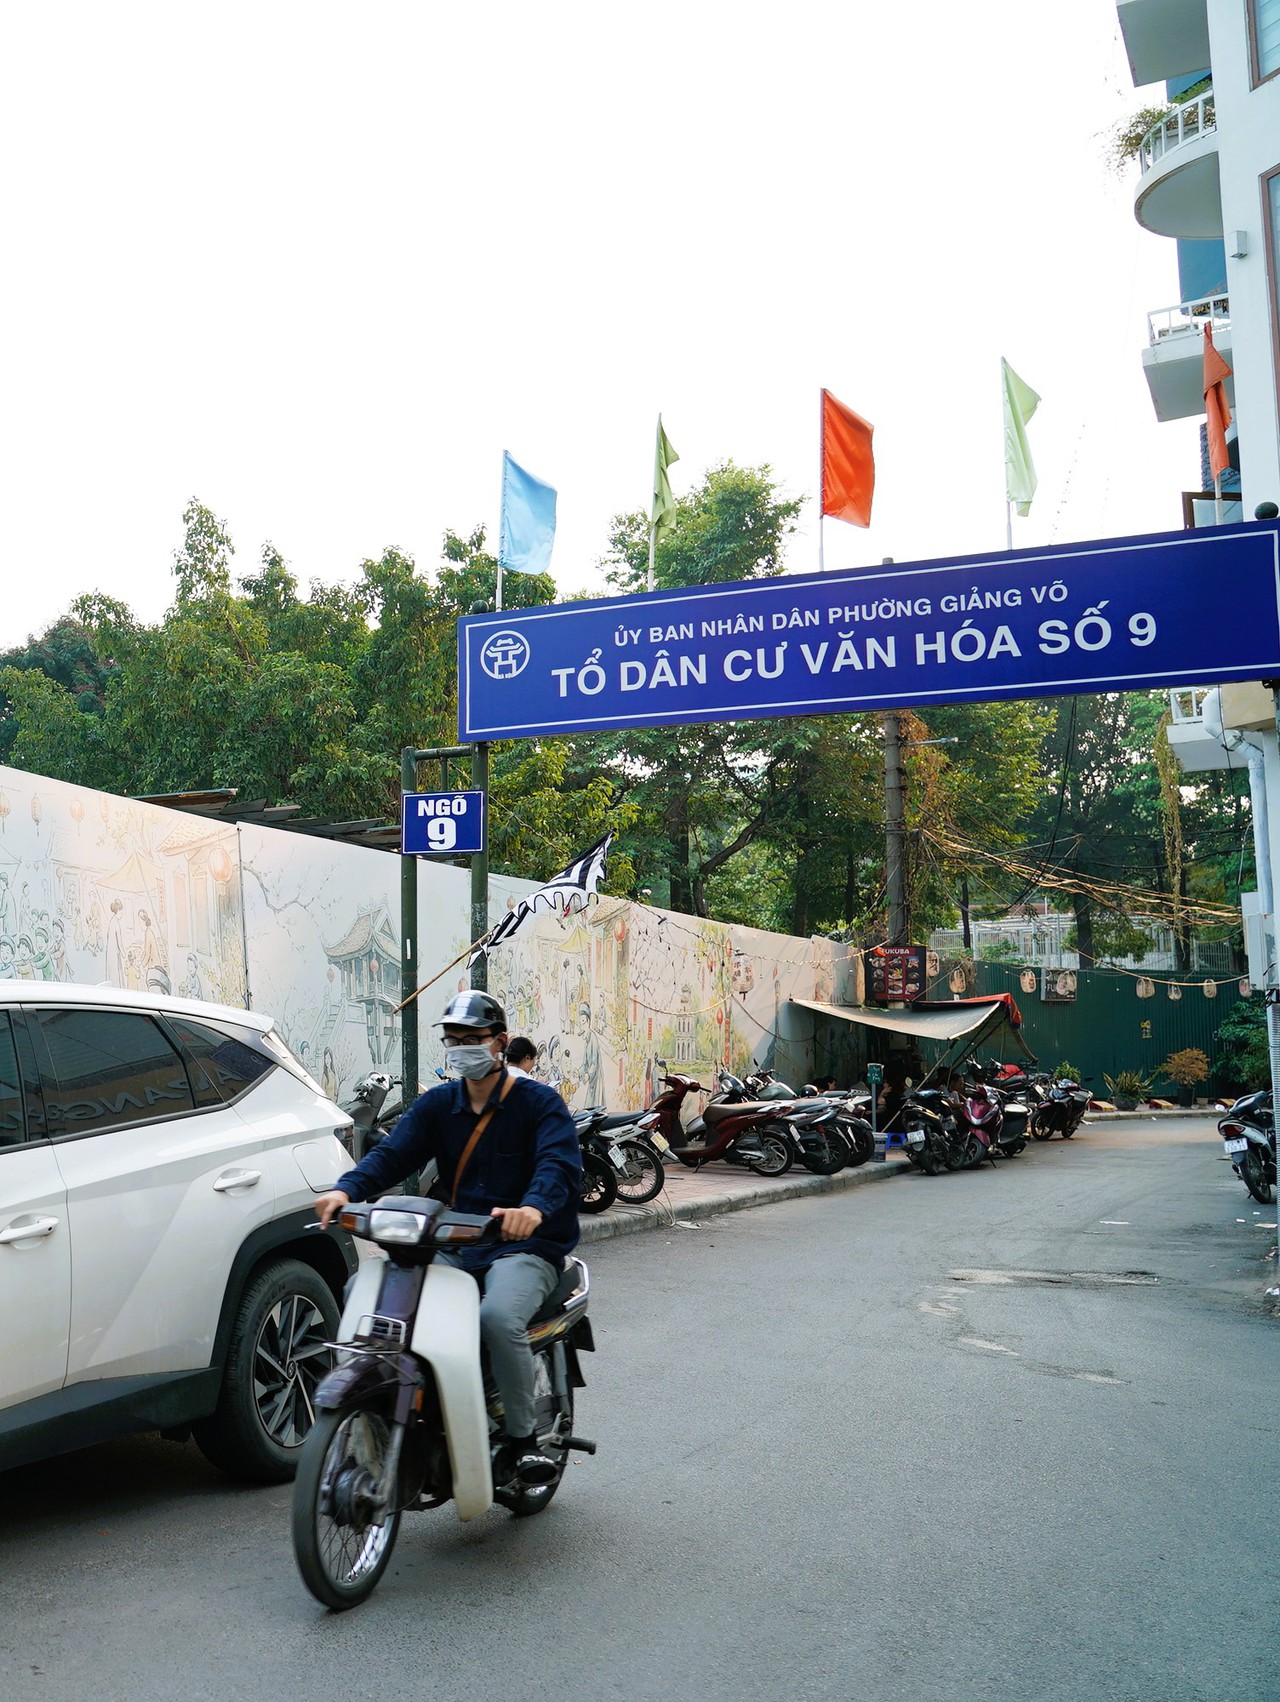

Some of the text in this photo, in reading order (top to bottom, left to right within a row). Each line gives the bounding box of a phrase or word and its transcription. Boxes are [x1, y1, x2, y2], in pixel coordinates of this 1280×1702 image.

[614, 579, 1069, 647] ỦY BAN NHÂN DÂN PHƯỜNG GIẢNG VÕ
[551, 600, 1157, 698] TỔ DÂN CƯ VĂN HÓA SỐ 9
[417, 794, 467, 817] NGÕ
[427, 816, 457, 850] 9
